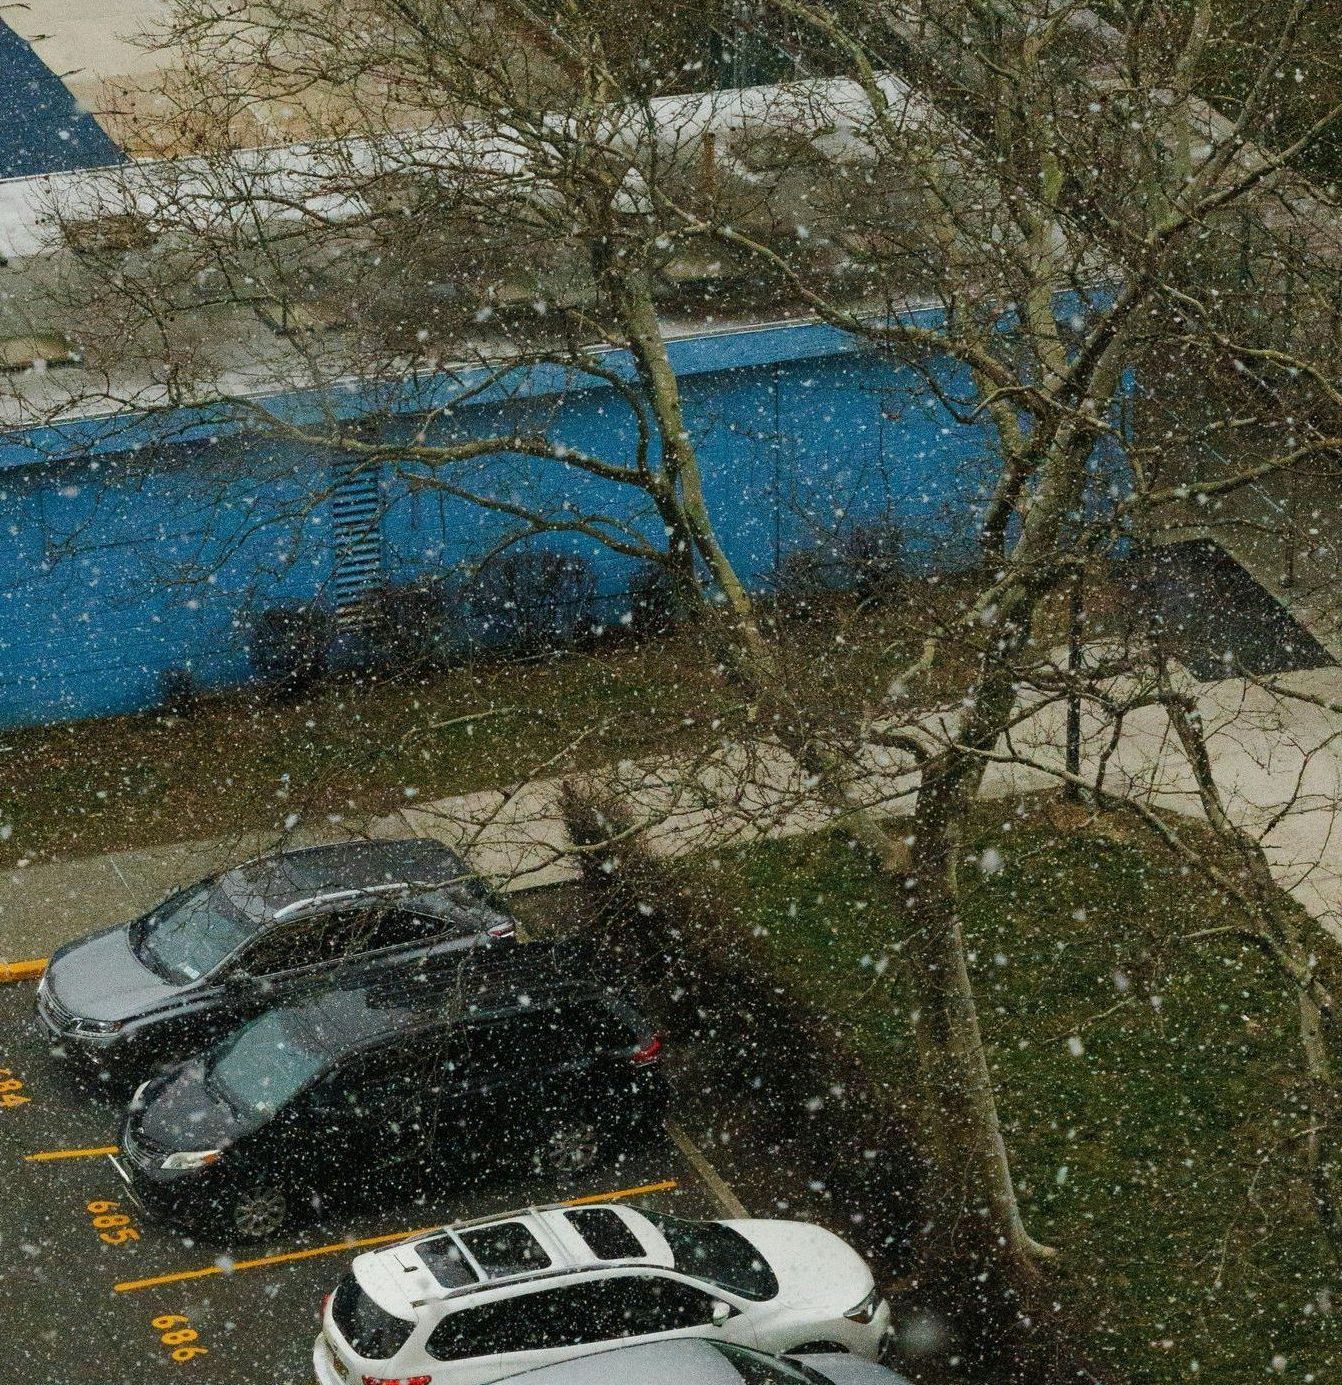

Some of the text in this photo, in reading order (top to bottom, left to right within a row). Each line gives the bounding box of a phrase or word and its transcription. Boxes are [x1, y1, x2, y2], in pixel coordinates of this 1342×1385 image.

[0, 1068, 32, 1108] 84
[87, 1200, 141, 1245] 685
[151, 1313, 207, 1363] 686
